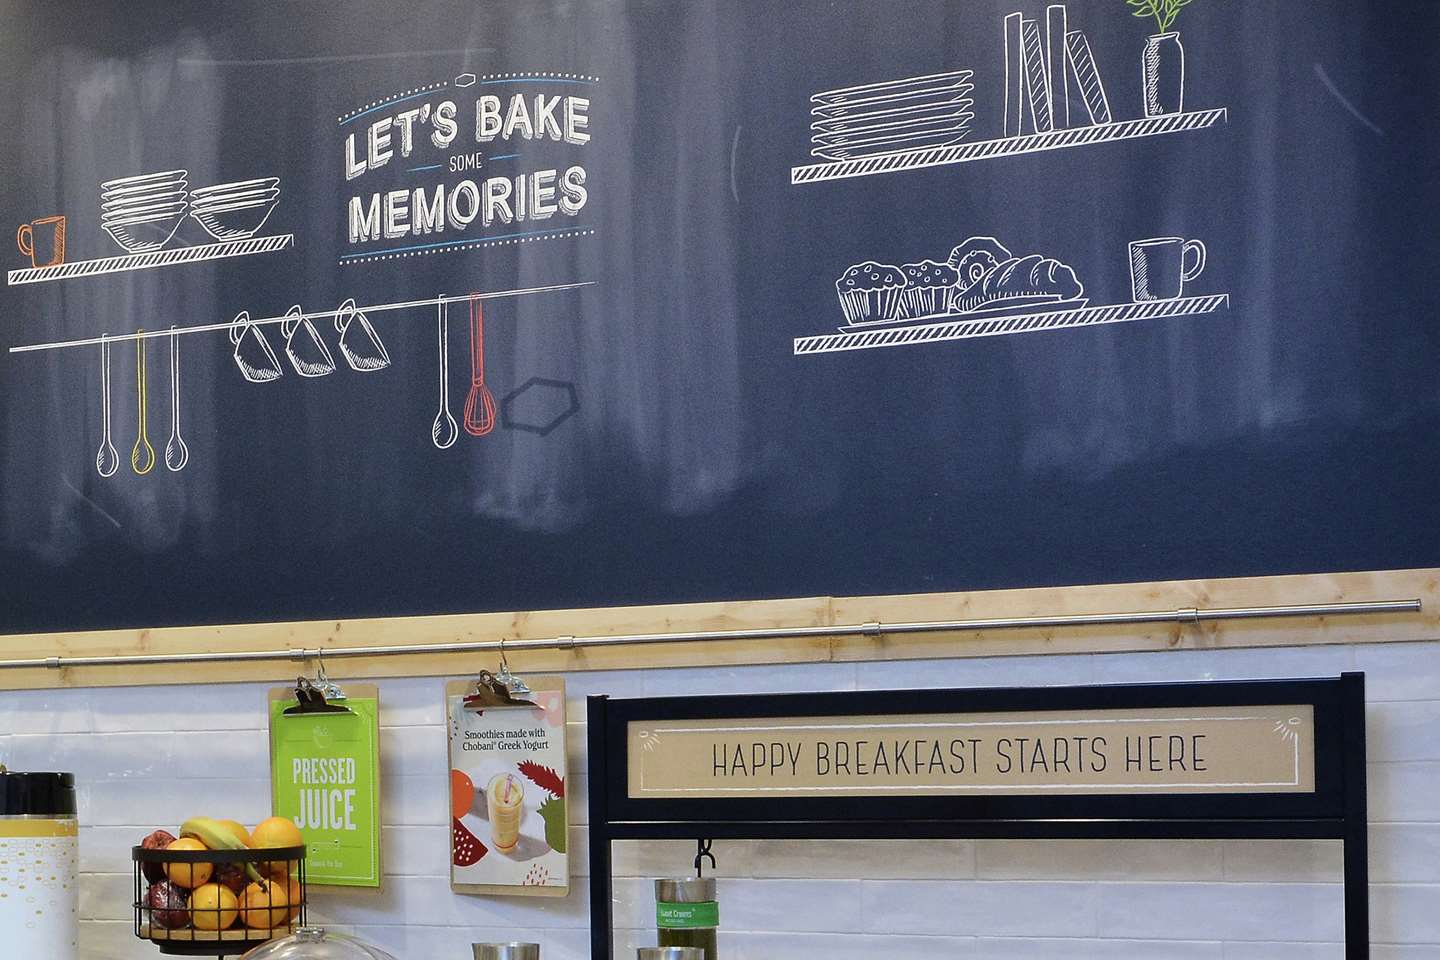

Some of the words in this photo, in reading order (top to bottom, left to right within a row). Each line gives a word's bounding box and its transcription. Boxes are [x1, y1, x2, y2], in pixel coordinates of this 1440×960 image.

[345, 100, 458, 181] LET'S
[475, 94, 591, 145] BAKE
[449, 152, 482, 172] SOME
[348, 165, 588, 243] MEMORIES
[464, 730, 505, 740] Smoothies
[506, 728, 527, 739] made
[529, 728, 546, 738] with
[498, 740, 522, 750] Greek
[523, 740, 549, 752] Yogurt
[293, 757, 356, 785] PRESSED
[713, 742, 802, 776] HAPPY
[816, 739, 982, 775] BREAKFAST
[997, 736, 1107, 773] STARTS
[1125, 735, 1208, 772] HERE
[293, 788, 357, 831] JUICE
